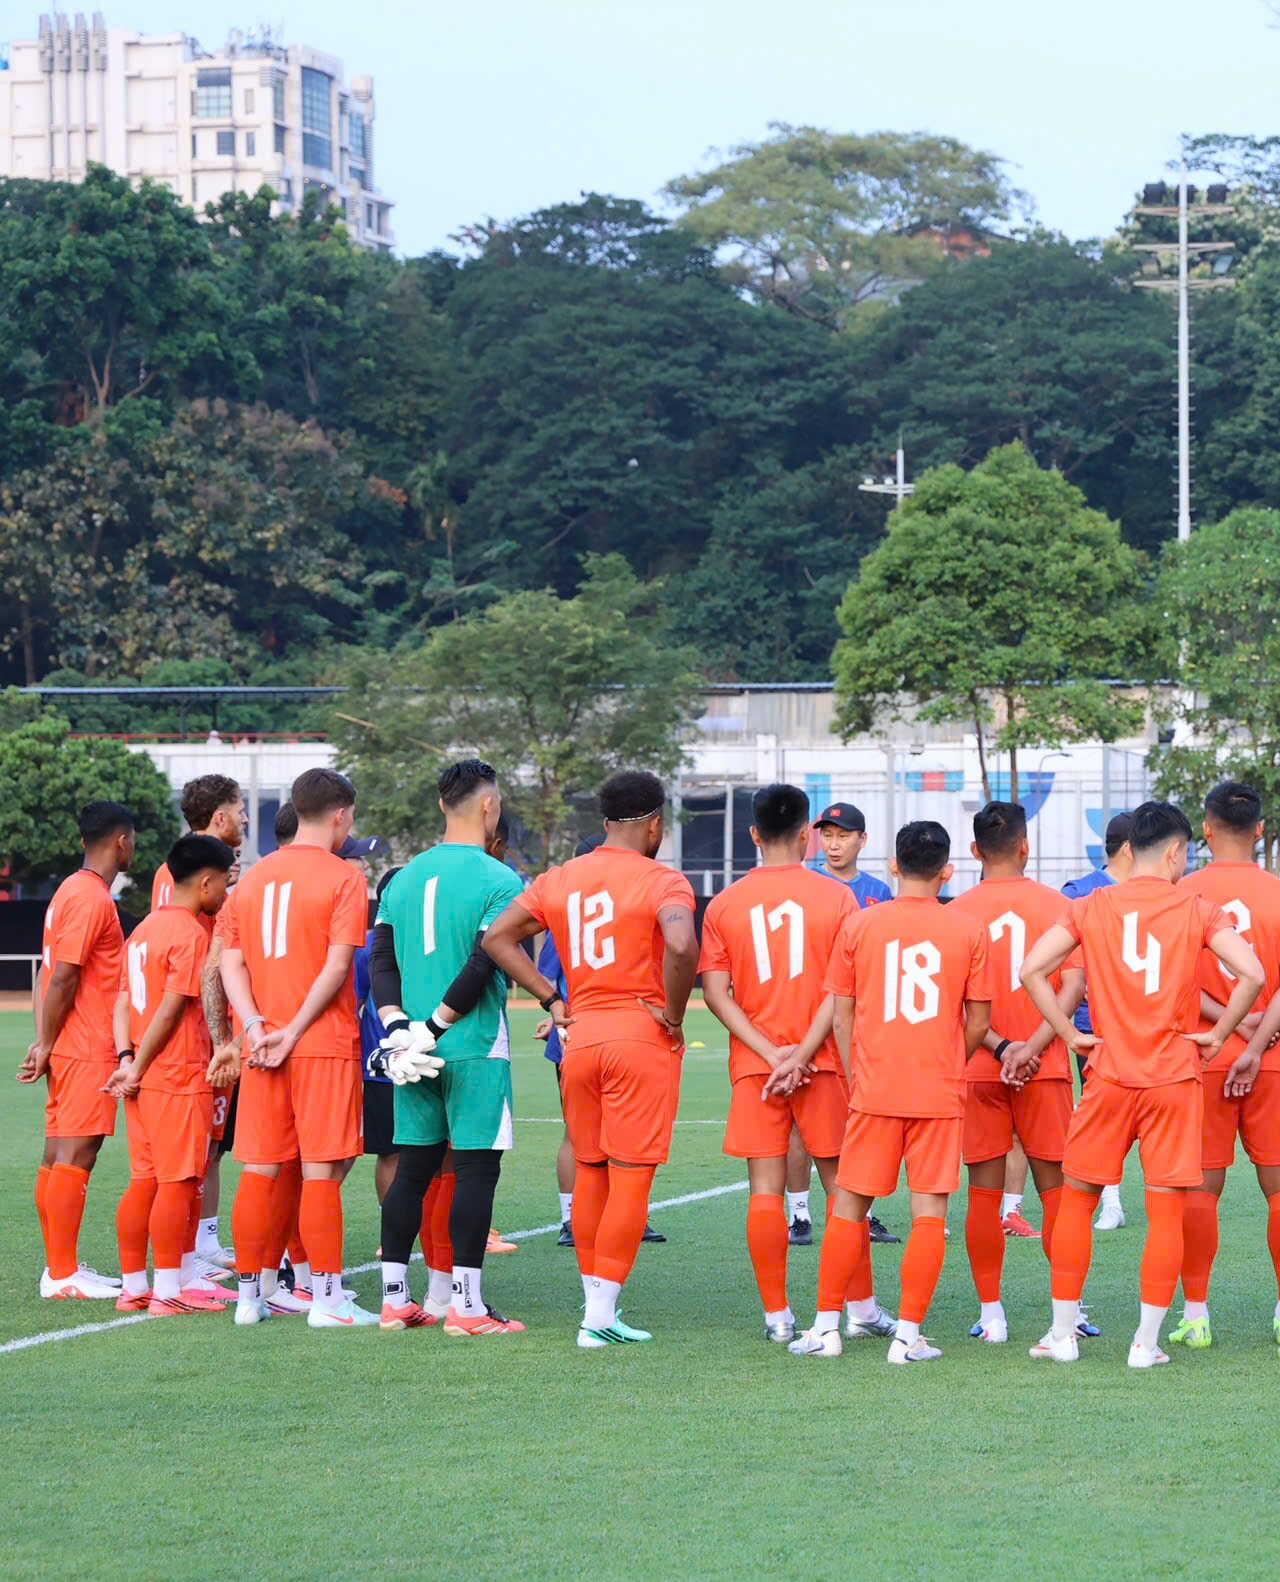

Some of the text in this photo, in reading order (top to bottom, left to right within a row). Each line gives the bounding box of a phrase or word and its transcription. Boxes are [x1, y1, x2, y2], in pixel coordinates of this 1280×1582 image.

[261, 880, 293, 960] 11
[423, 876, 439, 955] 1
[567, 889, 616, 971] 12
[749, 899, 804, 984] 17
[989, 910, 1026, 992] 7
[1122, 911, 1162, 996] 4
[883, 939, 942, 1025] 18
[213, 1095, 227, 1126] 3
